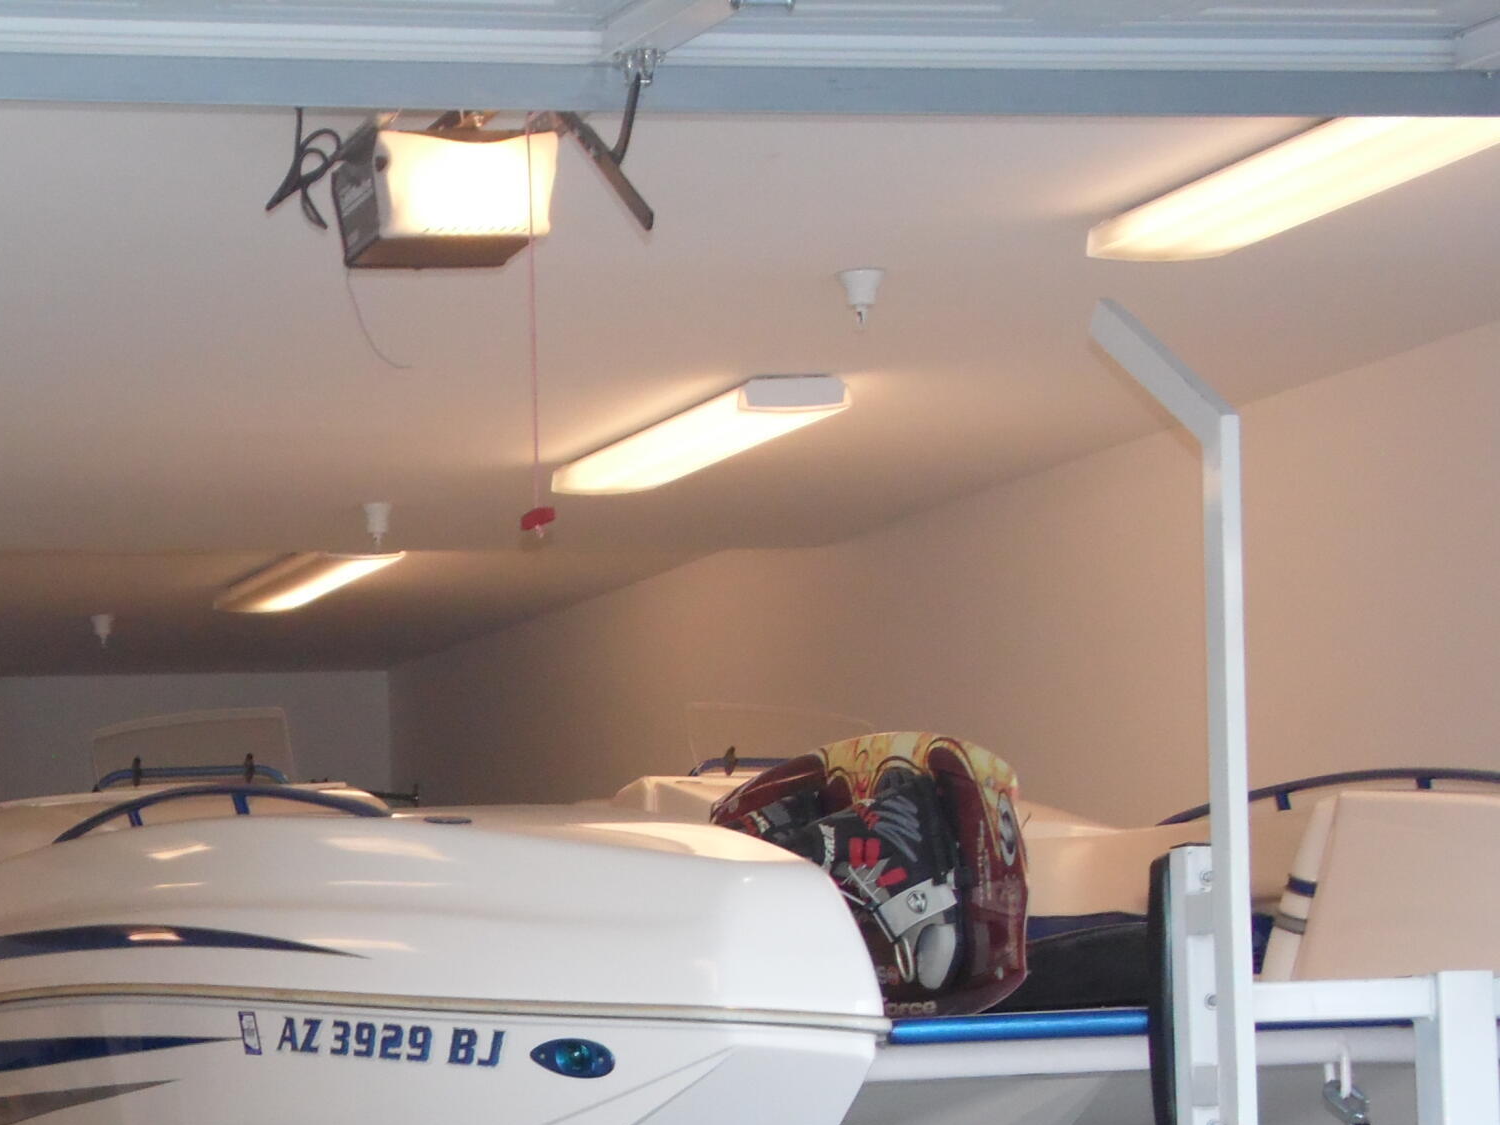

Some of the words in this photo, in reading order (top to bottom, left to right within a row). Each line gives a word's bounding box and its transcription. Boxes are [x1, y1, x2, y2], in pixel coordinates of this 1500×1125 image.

[277, 1016, 323, 1053] AZ
[330, 1019, 432, 1063] 3929
[447, 1027, 506, 1068] BJ
